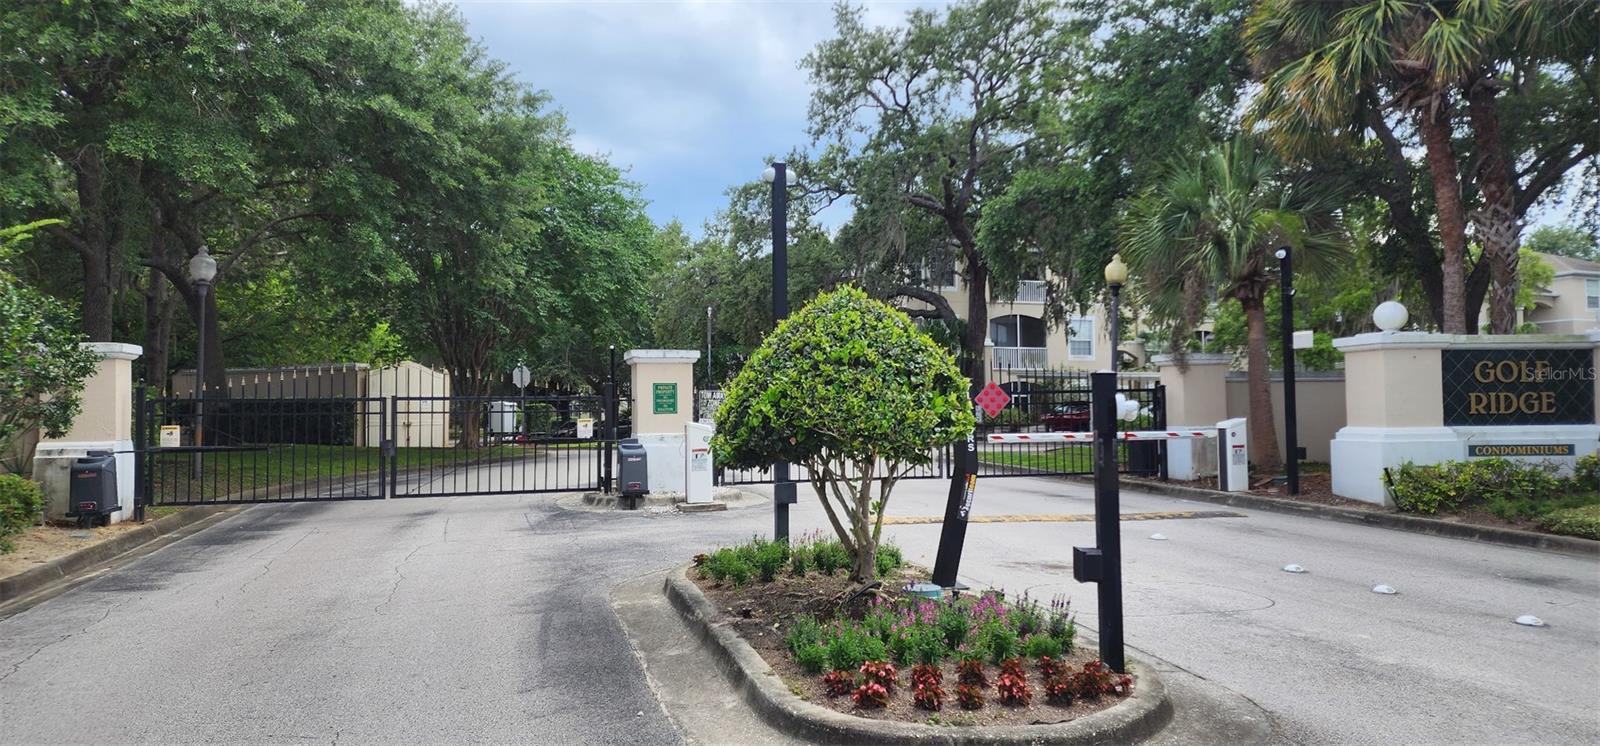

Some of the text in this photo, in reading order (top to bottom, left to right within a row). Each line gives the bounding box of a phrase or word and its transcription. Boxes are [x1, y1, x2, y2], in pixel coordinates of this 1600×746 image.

[1474, 360, 1550, 383] GOLF
[1468, 391, 1557, 414] RIDGE
[1475, 446, 1569, 455] CONDOMINIUMS
